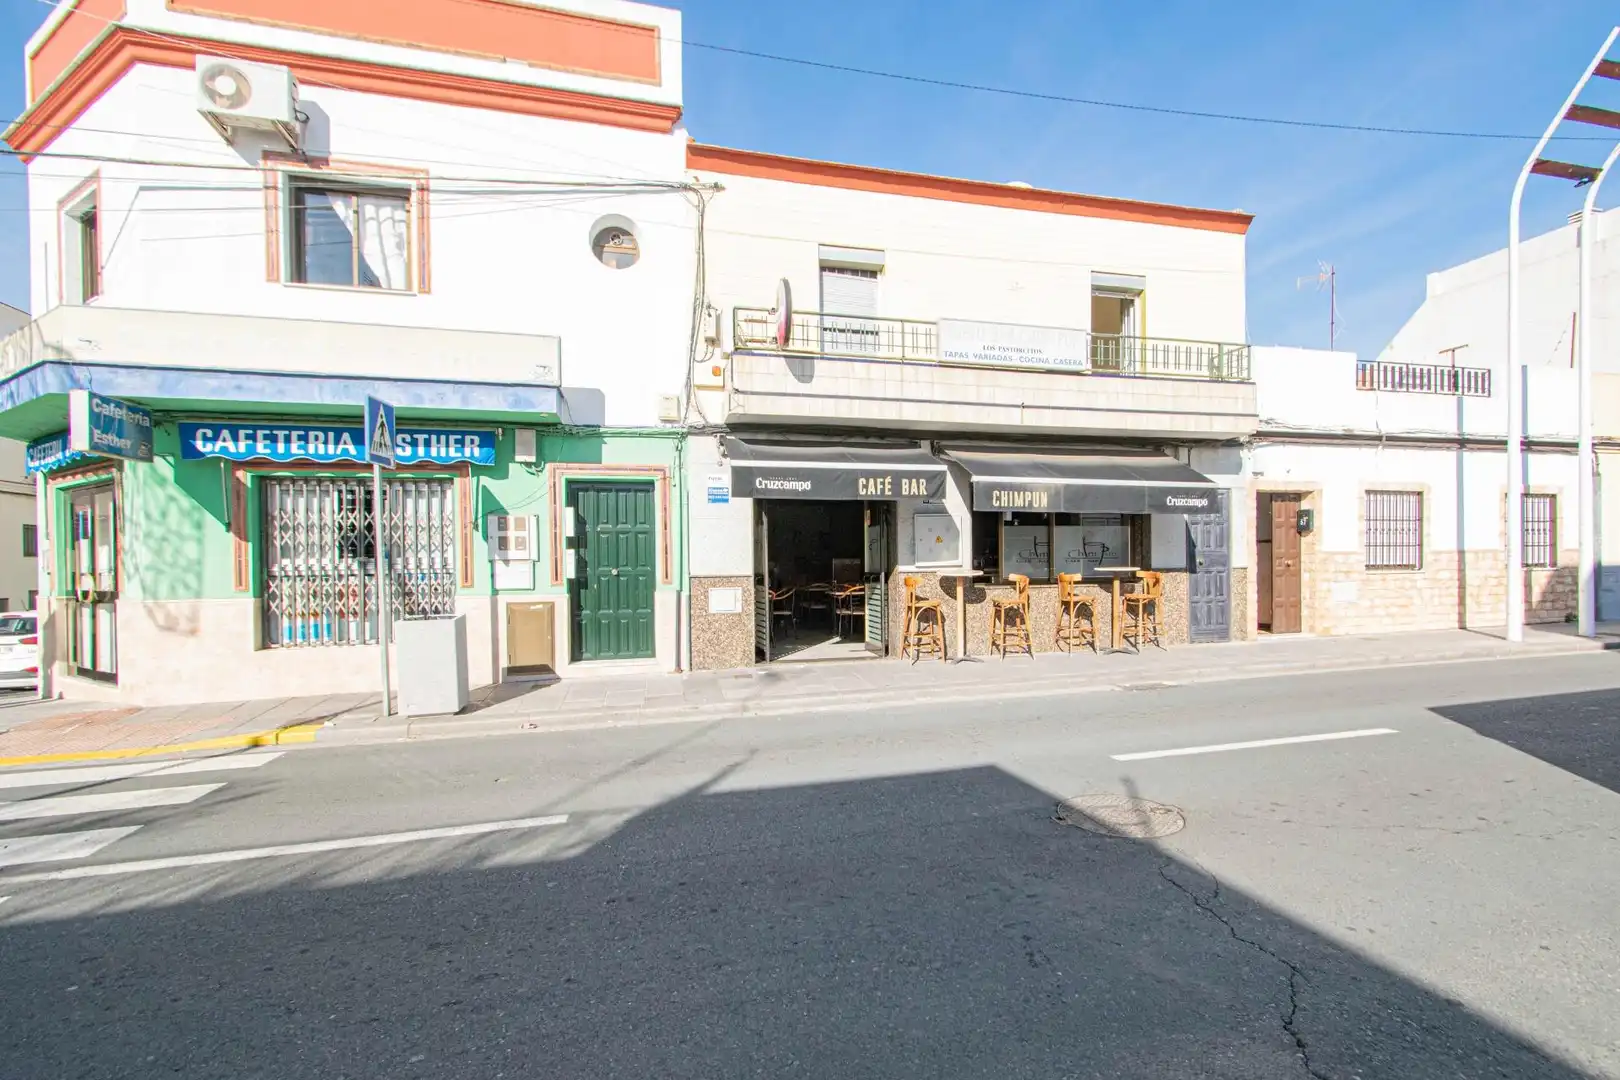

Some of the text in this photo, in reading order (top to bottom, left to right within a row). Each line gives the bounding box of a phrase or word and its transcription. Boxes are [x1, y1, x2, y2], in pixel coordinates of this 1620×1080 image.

[943, 350, 969, 359] TAPAS
[972, 352, 1012, 362] VARIADAS
[1019, 356, 1050, 365] COCINA
[1053, 358, 1083, 367] CASERA
[92, 397, 150, 428] Cafeteria
[92, 428, 131, 449] Esther
[195, 428, 480, 458] CAFETERIA STHER
[755, 477, 811, 491] Cruzcampo
[858, 475, 928, 496] CAFÉ BAR
[992, 490, 1048, 508] CHIMPUN
[1166, 495, 1208, 507] Cruzcampo
